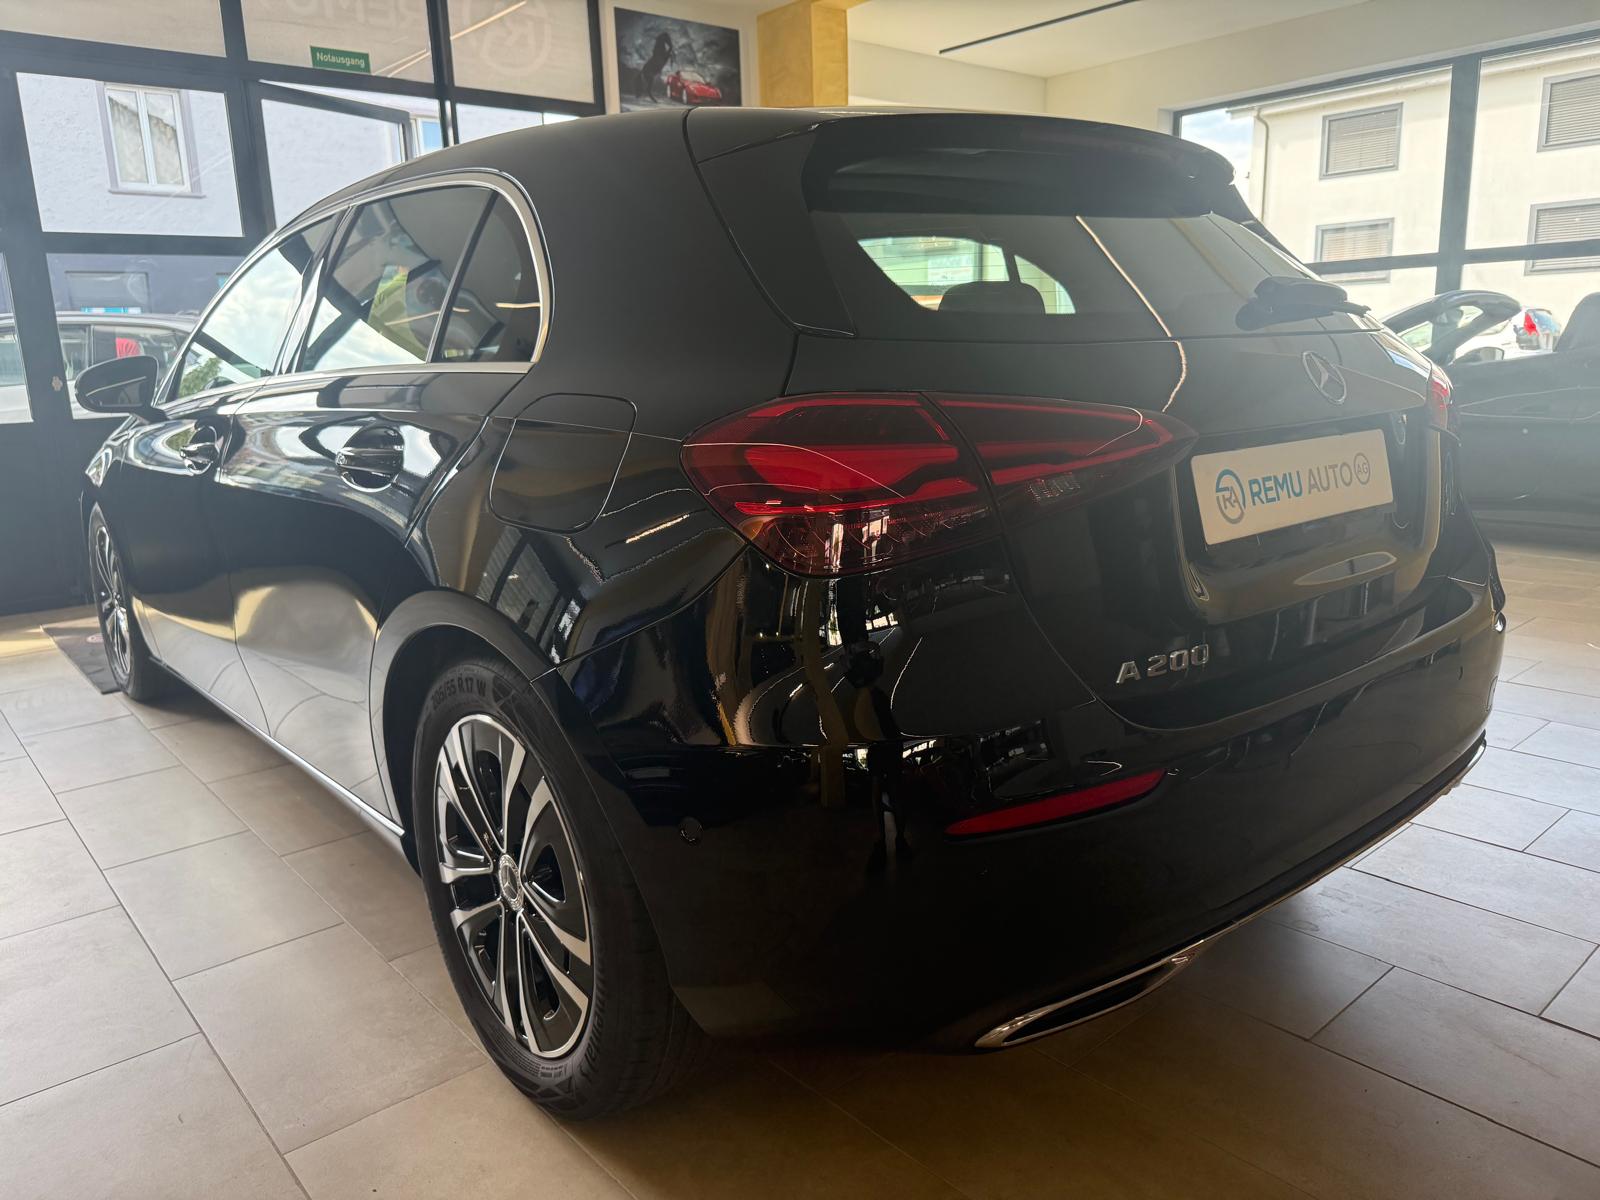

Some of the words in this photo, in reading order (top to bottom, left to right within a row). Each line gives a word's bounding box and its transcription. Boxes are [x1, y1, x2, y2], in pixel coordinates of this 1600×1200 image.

[316, 51, 366, 69] Notausgang
[1248, 470, 1304, 507] REMU
[1308, 462, 1354, 495] AUTO
[1356, 462, 1369, 474] AG
[1116, 660, 1141, 684] A
[1147, 643, 1209, 677] 200
